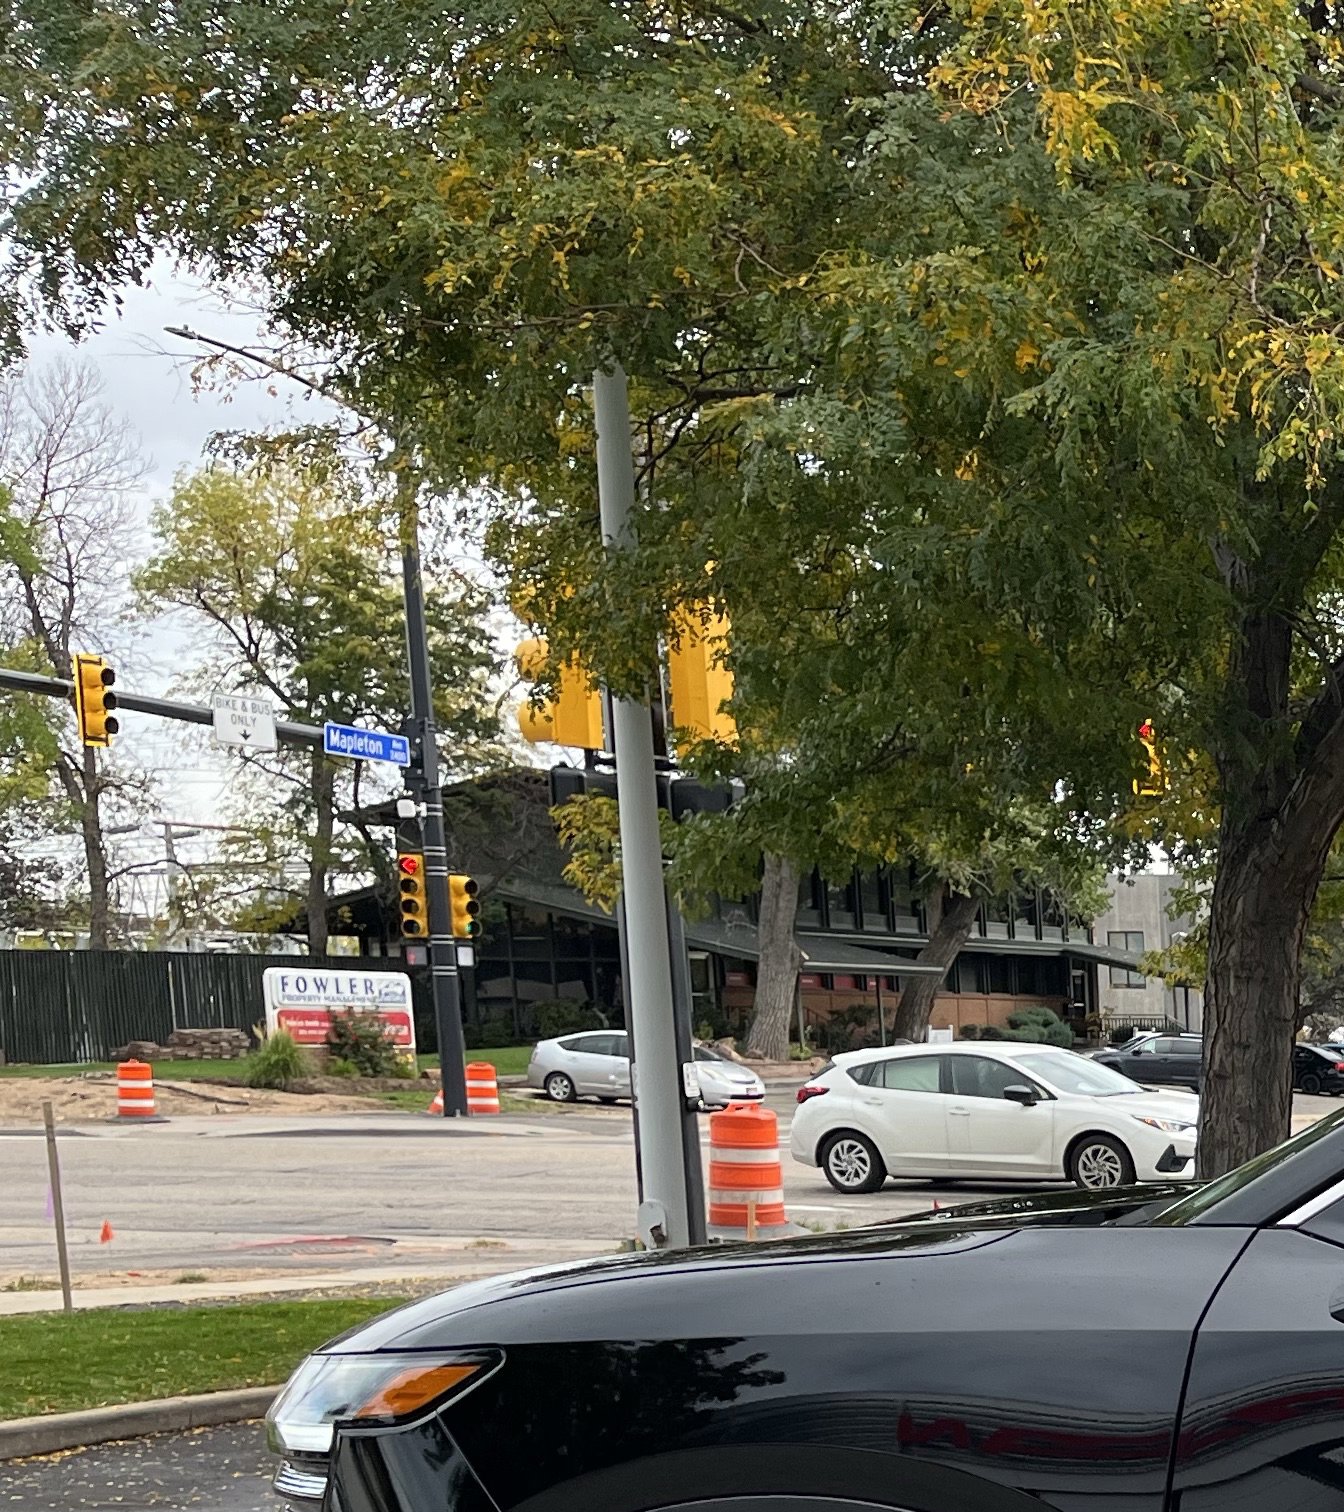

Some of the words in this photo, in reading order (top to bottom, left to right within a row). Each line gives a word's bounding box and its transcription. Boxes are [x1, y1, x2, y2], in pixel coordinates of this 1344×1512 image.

[215, 697, 237, 711] BIKE
[241, 701, 248, 713] &
[251, 702, 270, 716] BUS
[230, 713, 257, 728] ONLY
[329, 728, 384, 756] Mapleton
[280, 975, 375, 995] FOWLER
[282, 993, 321, 1002] PROPERTY
